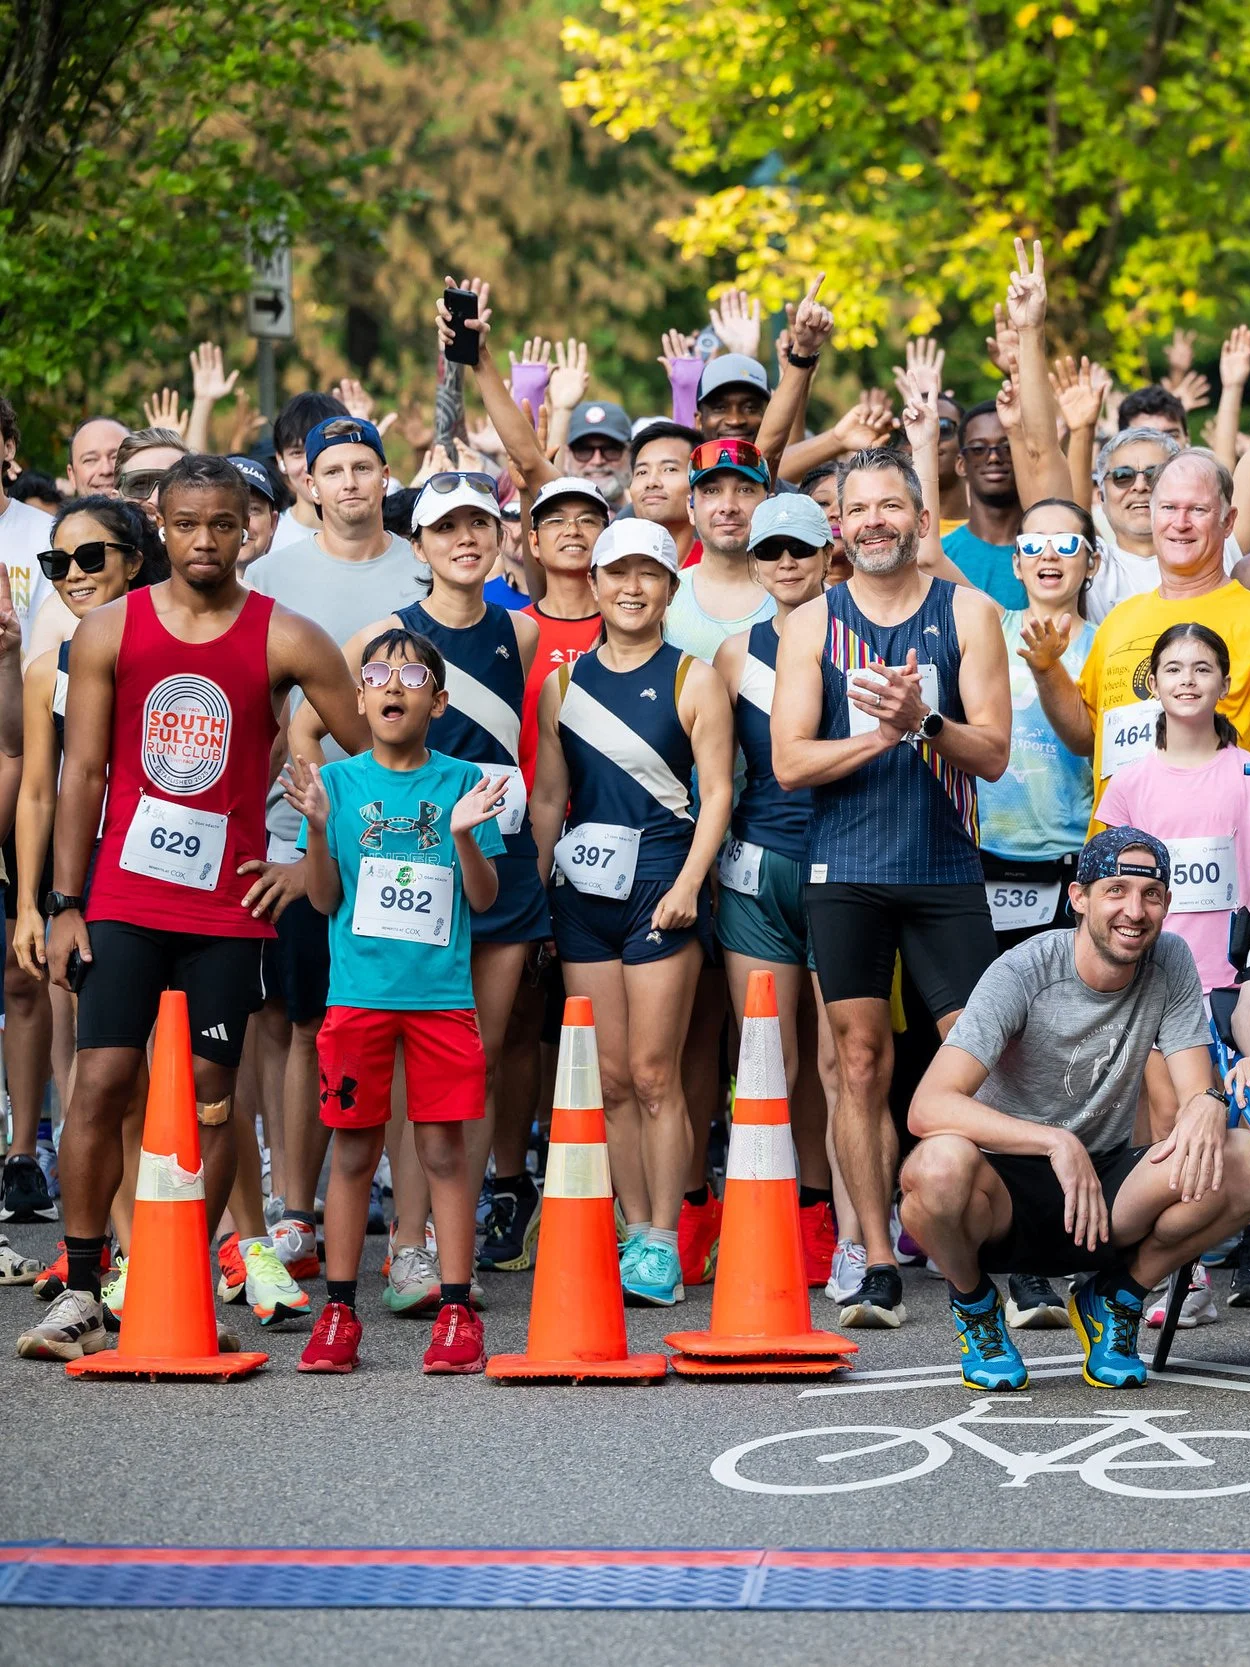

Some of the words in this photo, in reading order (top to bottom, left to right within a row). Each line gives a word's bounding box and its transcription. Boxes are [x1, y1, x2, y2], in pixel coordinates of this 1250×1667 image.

[148, 710, 227, 734] SOUTH
[147, 727, 224, 749] FULTON
[1114, 722, 1153, 747] 464
[146, 741, 178, 756] RUN
[181, 745, 222, 761] CLUB
[155, 765, 193, 785] ESTABLISHED
[194, 770, 209, 783] 2025
[151, 807, 167, 820] 5K
[150, 826, 201, 858] 629
[571, 844, 616, 869] 397
[170, 869, 186, 880] COX
[1173, 862, 1221, 885] 500
[380, 886, 432, 914] 982
[993, 888, 1038, 907] 536
[405, 927, 420, 936] COX
